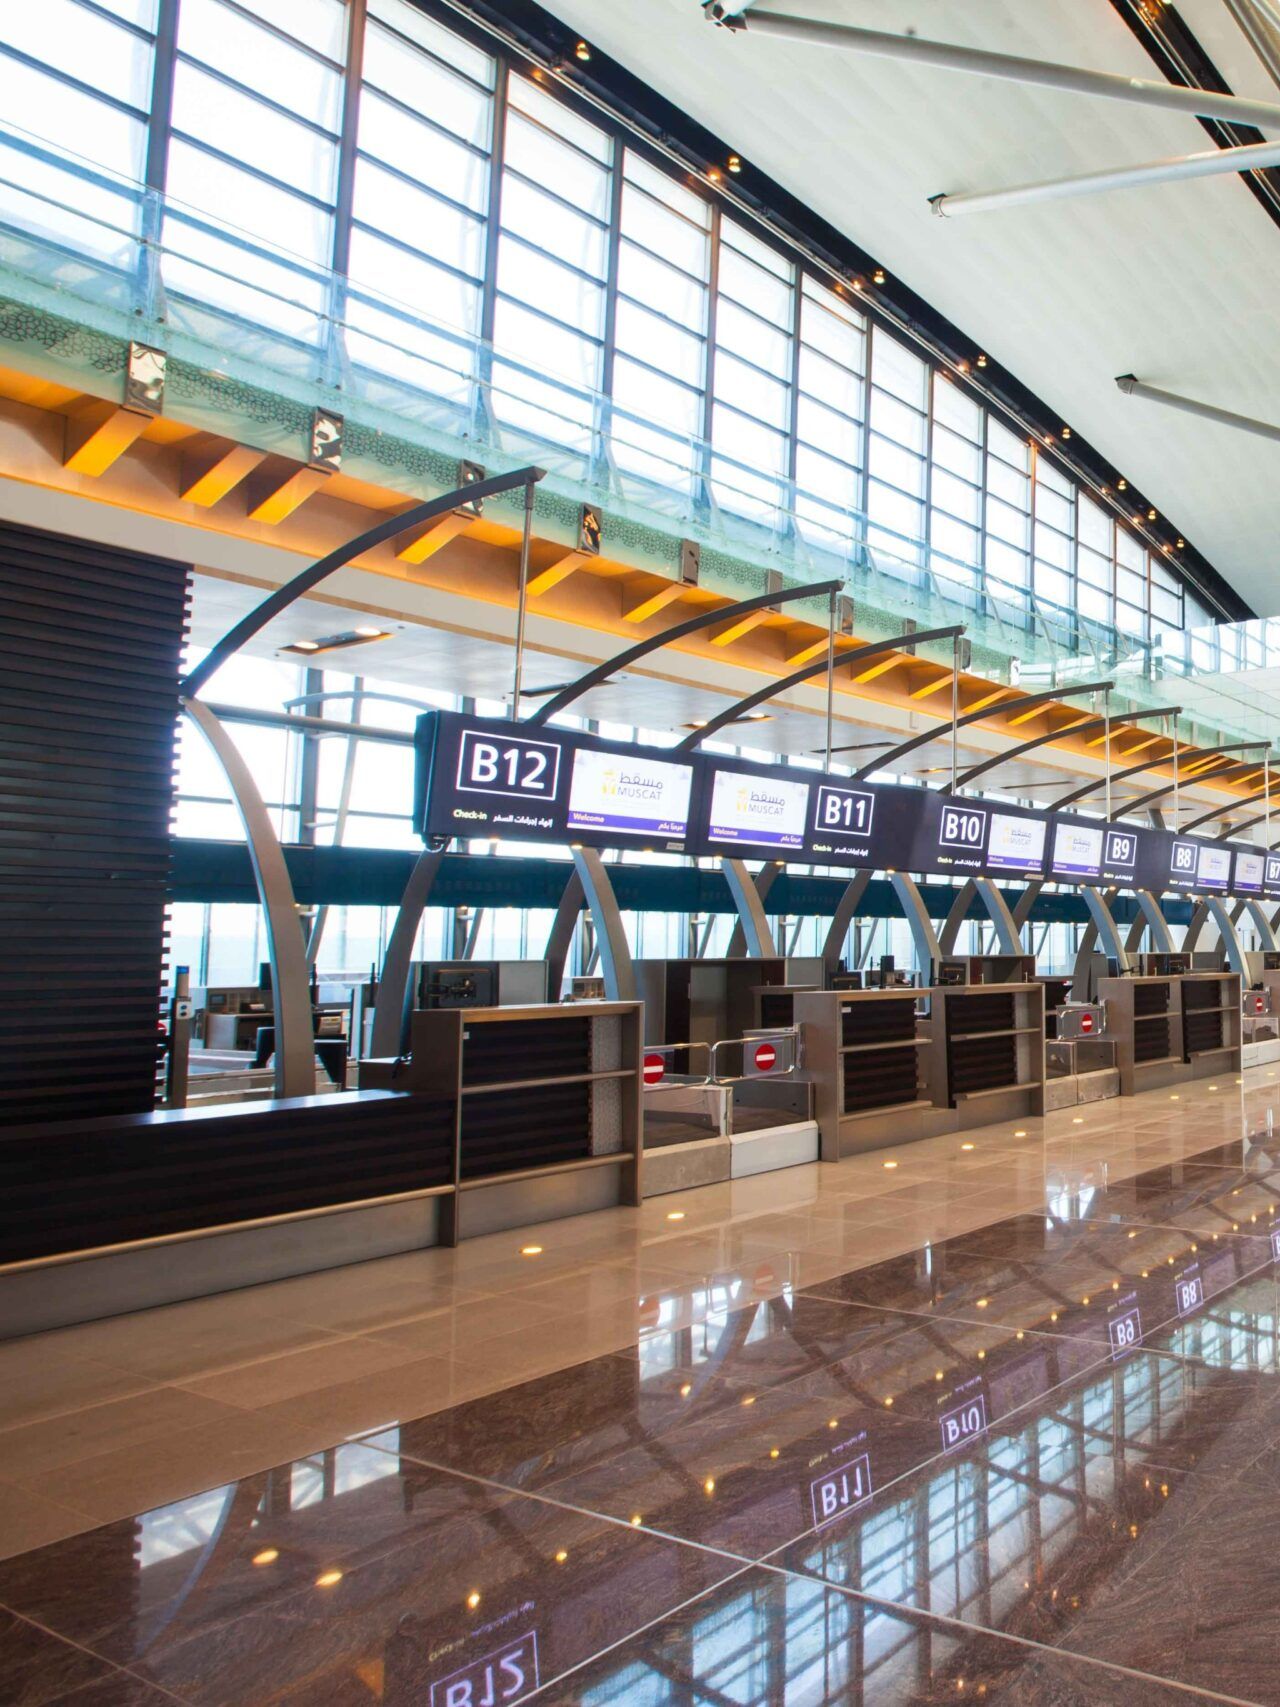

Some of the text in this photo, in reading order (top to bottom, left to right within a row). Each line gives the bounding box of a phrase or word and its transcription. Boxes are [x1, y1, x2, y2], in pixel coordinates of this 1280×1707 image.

[471, 743, 547, 789] B12
[620, 771, 663, 789] مسقط
[617, 786, 662, 800] MUSCAT
[750, 791, 785, 807] مسقط
[453, 808, 488, 820] Check-in
[573, 812, 605, 823] Welcome
[748, 803, 784, 815] MUSCAT
[825, 795, 866, 828] B11
[945, 813, 980, 842] B10
[1112, 837, 1130, 860] B9
[1176, 847, 1192, 868] B8
[1269, 861, 1280, 879] B7
